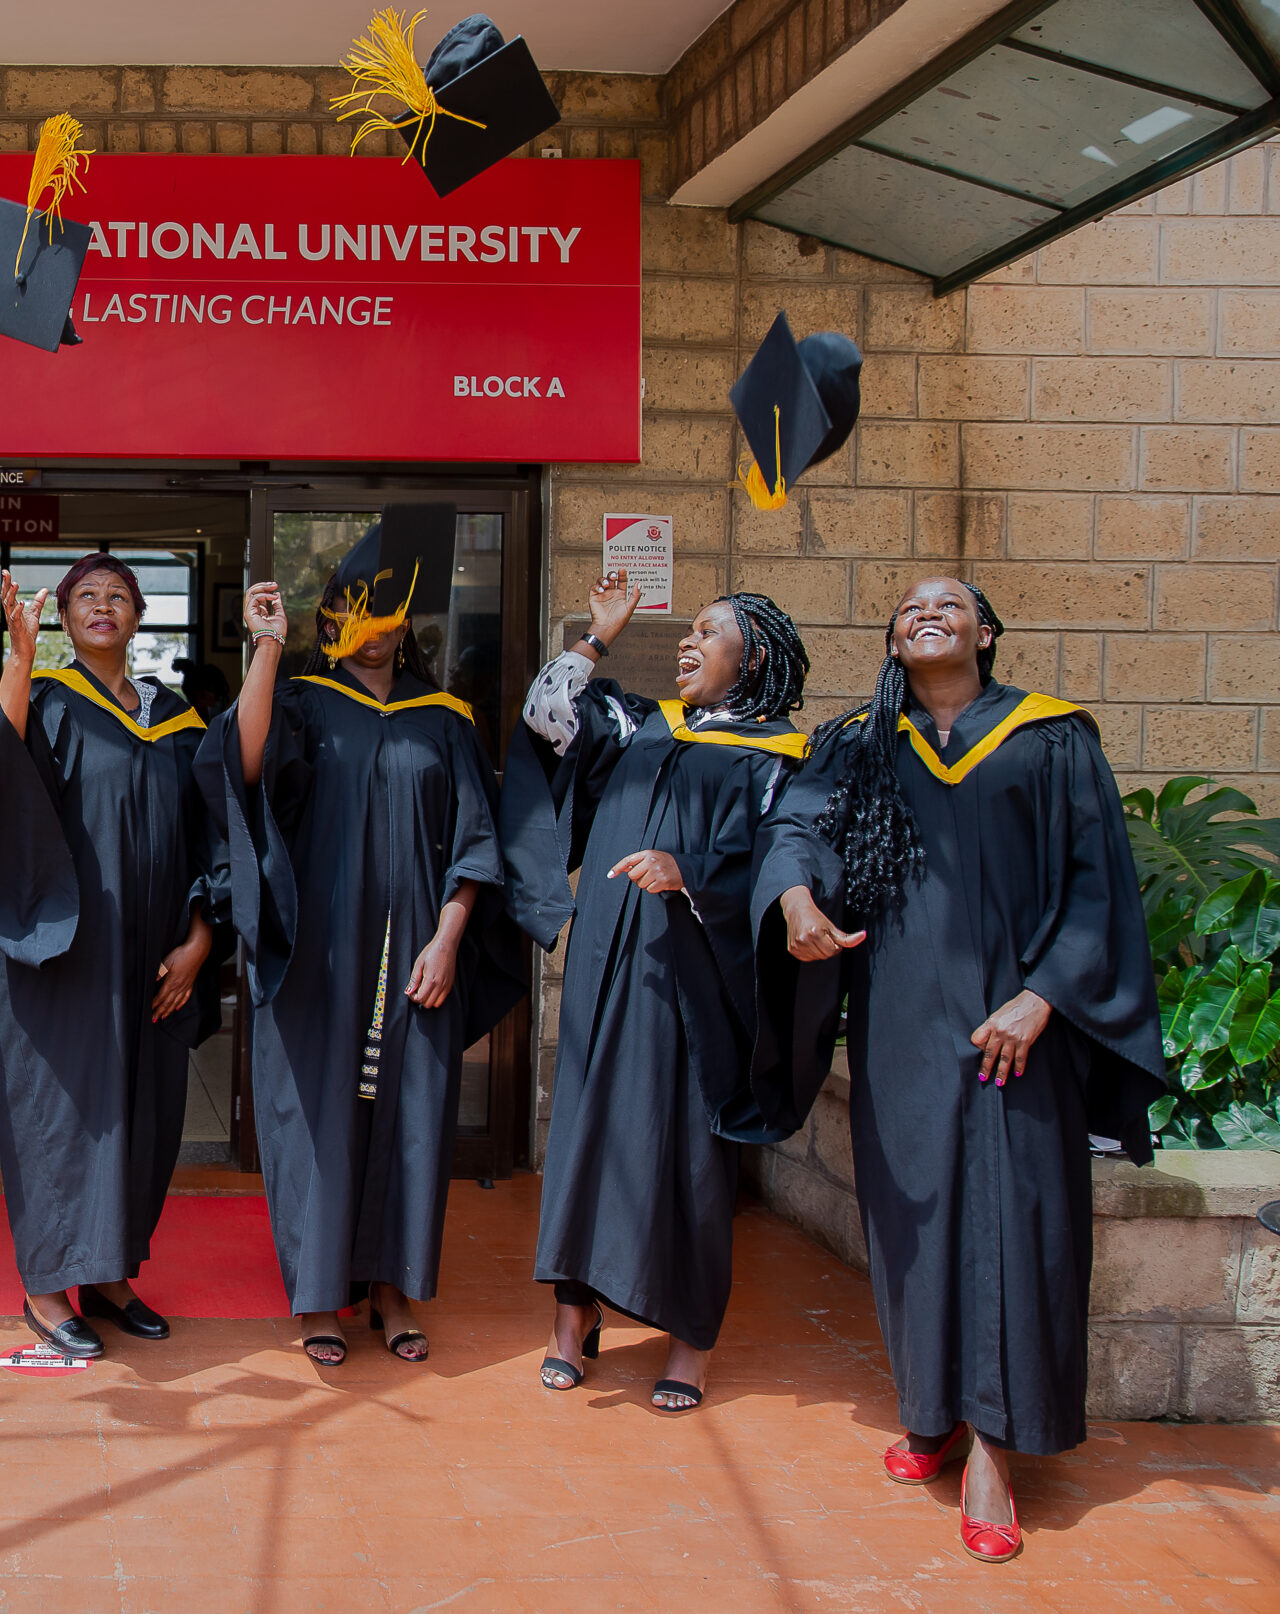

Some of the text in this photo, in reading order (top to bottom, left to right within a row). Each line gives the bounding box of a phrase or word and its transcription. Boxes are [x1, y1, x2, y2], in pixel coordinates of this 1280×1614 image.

[298, 223, 582, 263] UNIVERSITY
[82, 293, 394, 326] LASTING CHANGE
[453, 375, 566, 398] BLOCK A
